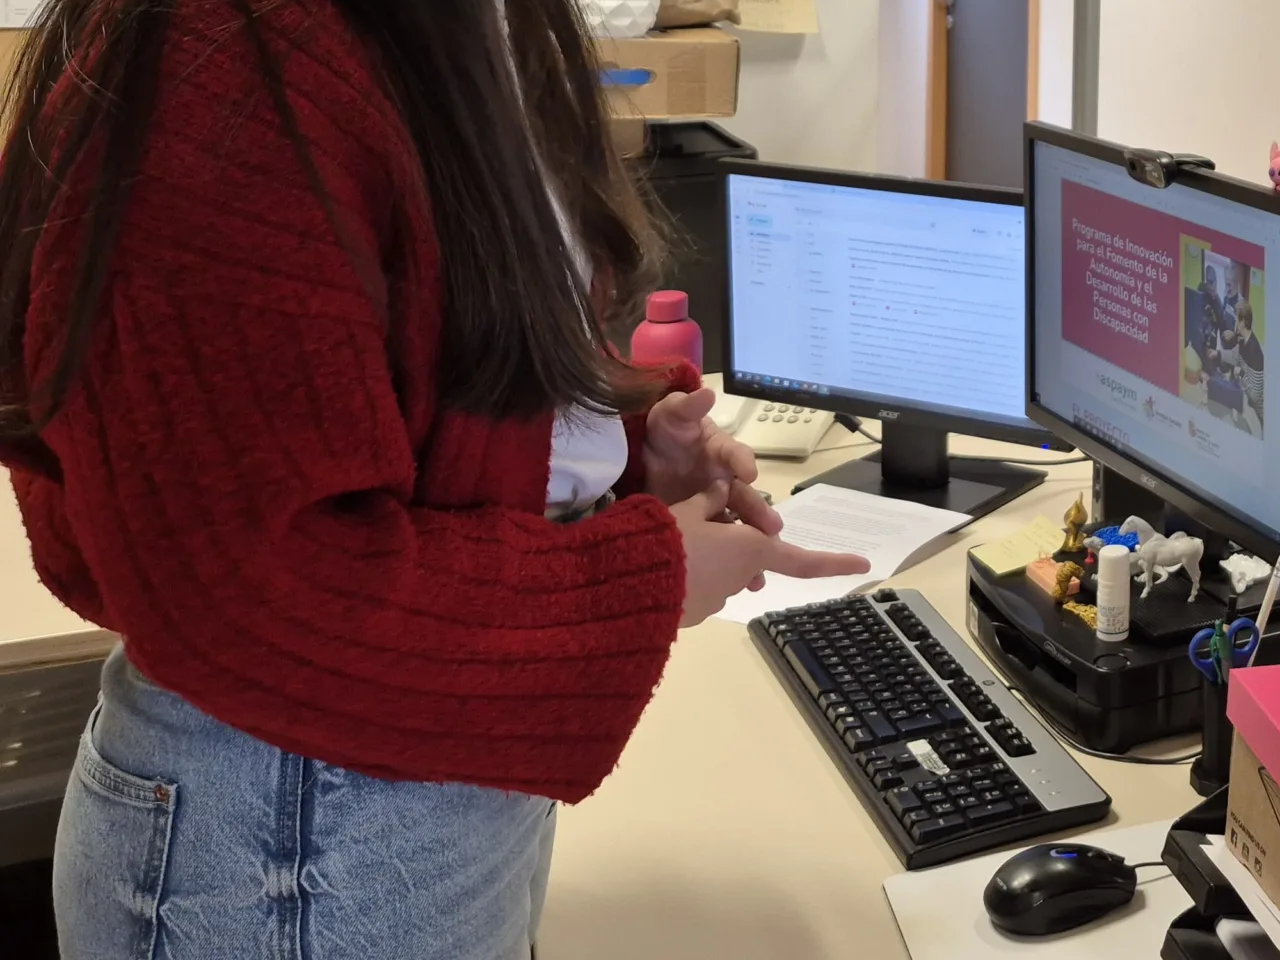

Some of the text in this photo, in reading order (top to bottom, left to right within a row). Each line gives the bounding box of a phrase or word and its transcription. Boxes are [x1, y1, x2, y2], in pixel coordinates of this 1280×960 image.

[1072, 217, 1173, 268] Programa de Innovación
[1076, 238, 1168, 284] para el Fomento de la
[1089, 258, 1153, 294] Autonomía y el
[1086, 271, 1157, 313] Desarrollo de las
[1093, 291, 1149, 327] Personas con
[1093, 307, 1149, 343] Discapacidad
[1100, 373, 1138, 402] aspaym
[879, 409, 900, 419] acer
[1140, 473, 1157, 489] acer
